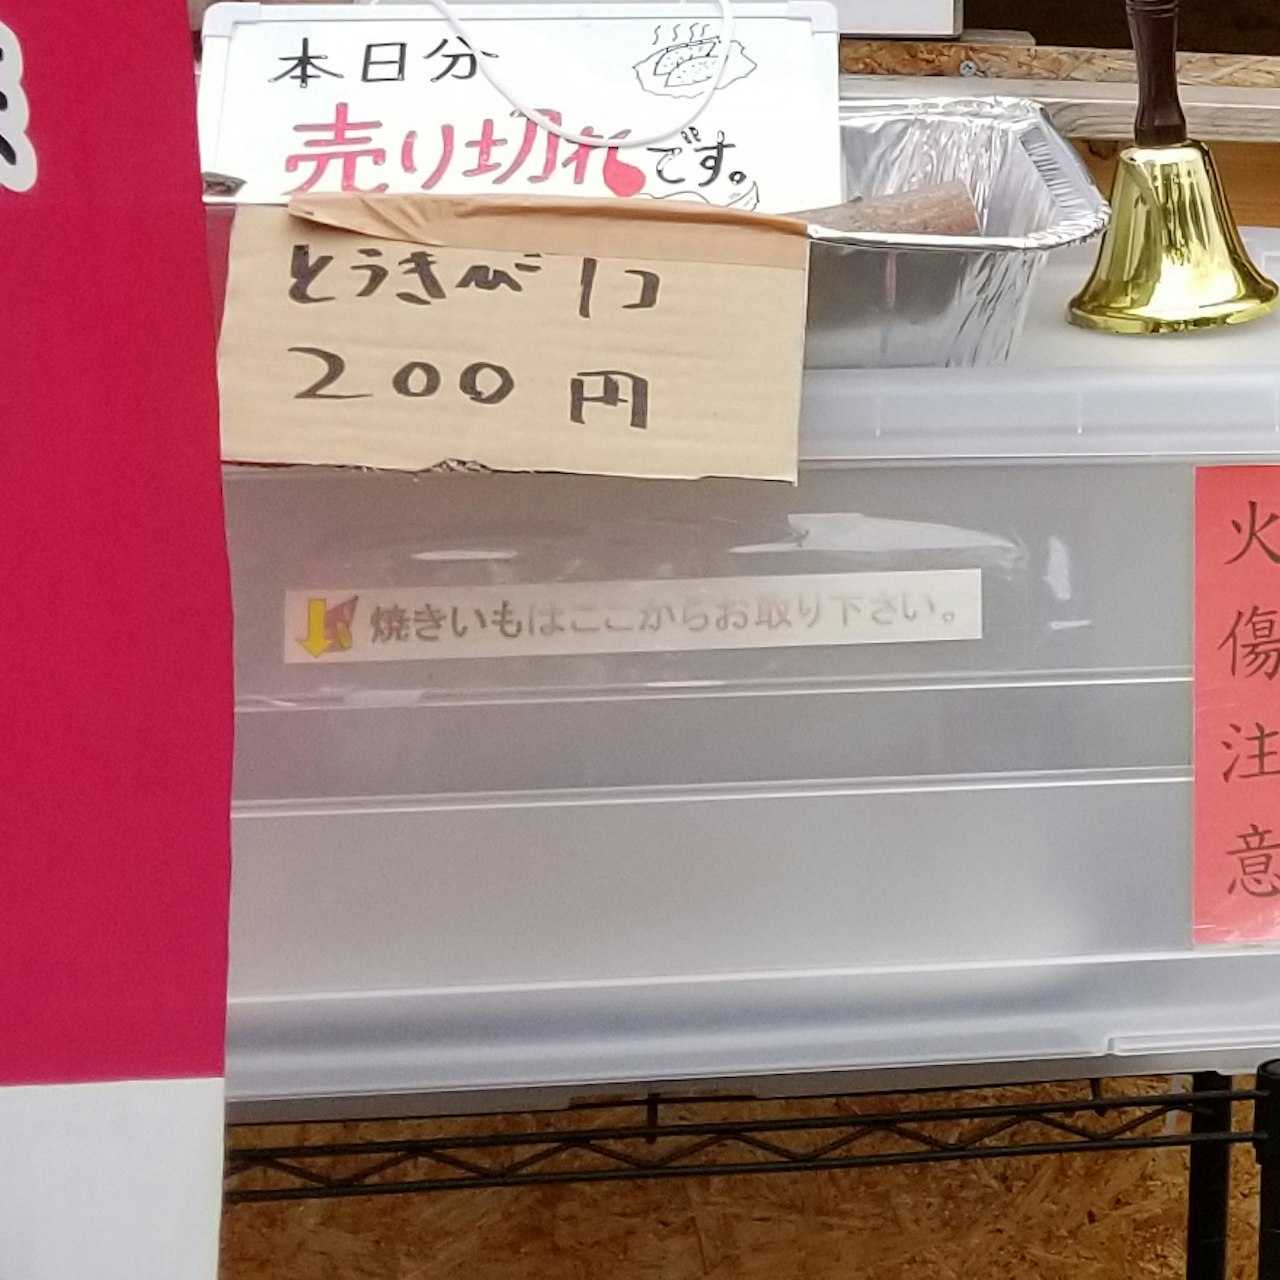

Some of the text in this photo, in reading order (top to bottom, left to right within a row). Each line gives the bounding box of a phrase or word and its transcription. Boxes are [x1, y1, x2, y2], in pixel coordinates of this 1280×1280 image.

[267, 37, 500, 88] 本日分
[369, 592, 957, 644] 焼きいもはここからお取り下さい。
